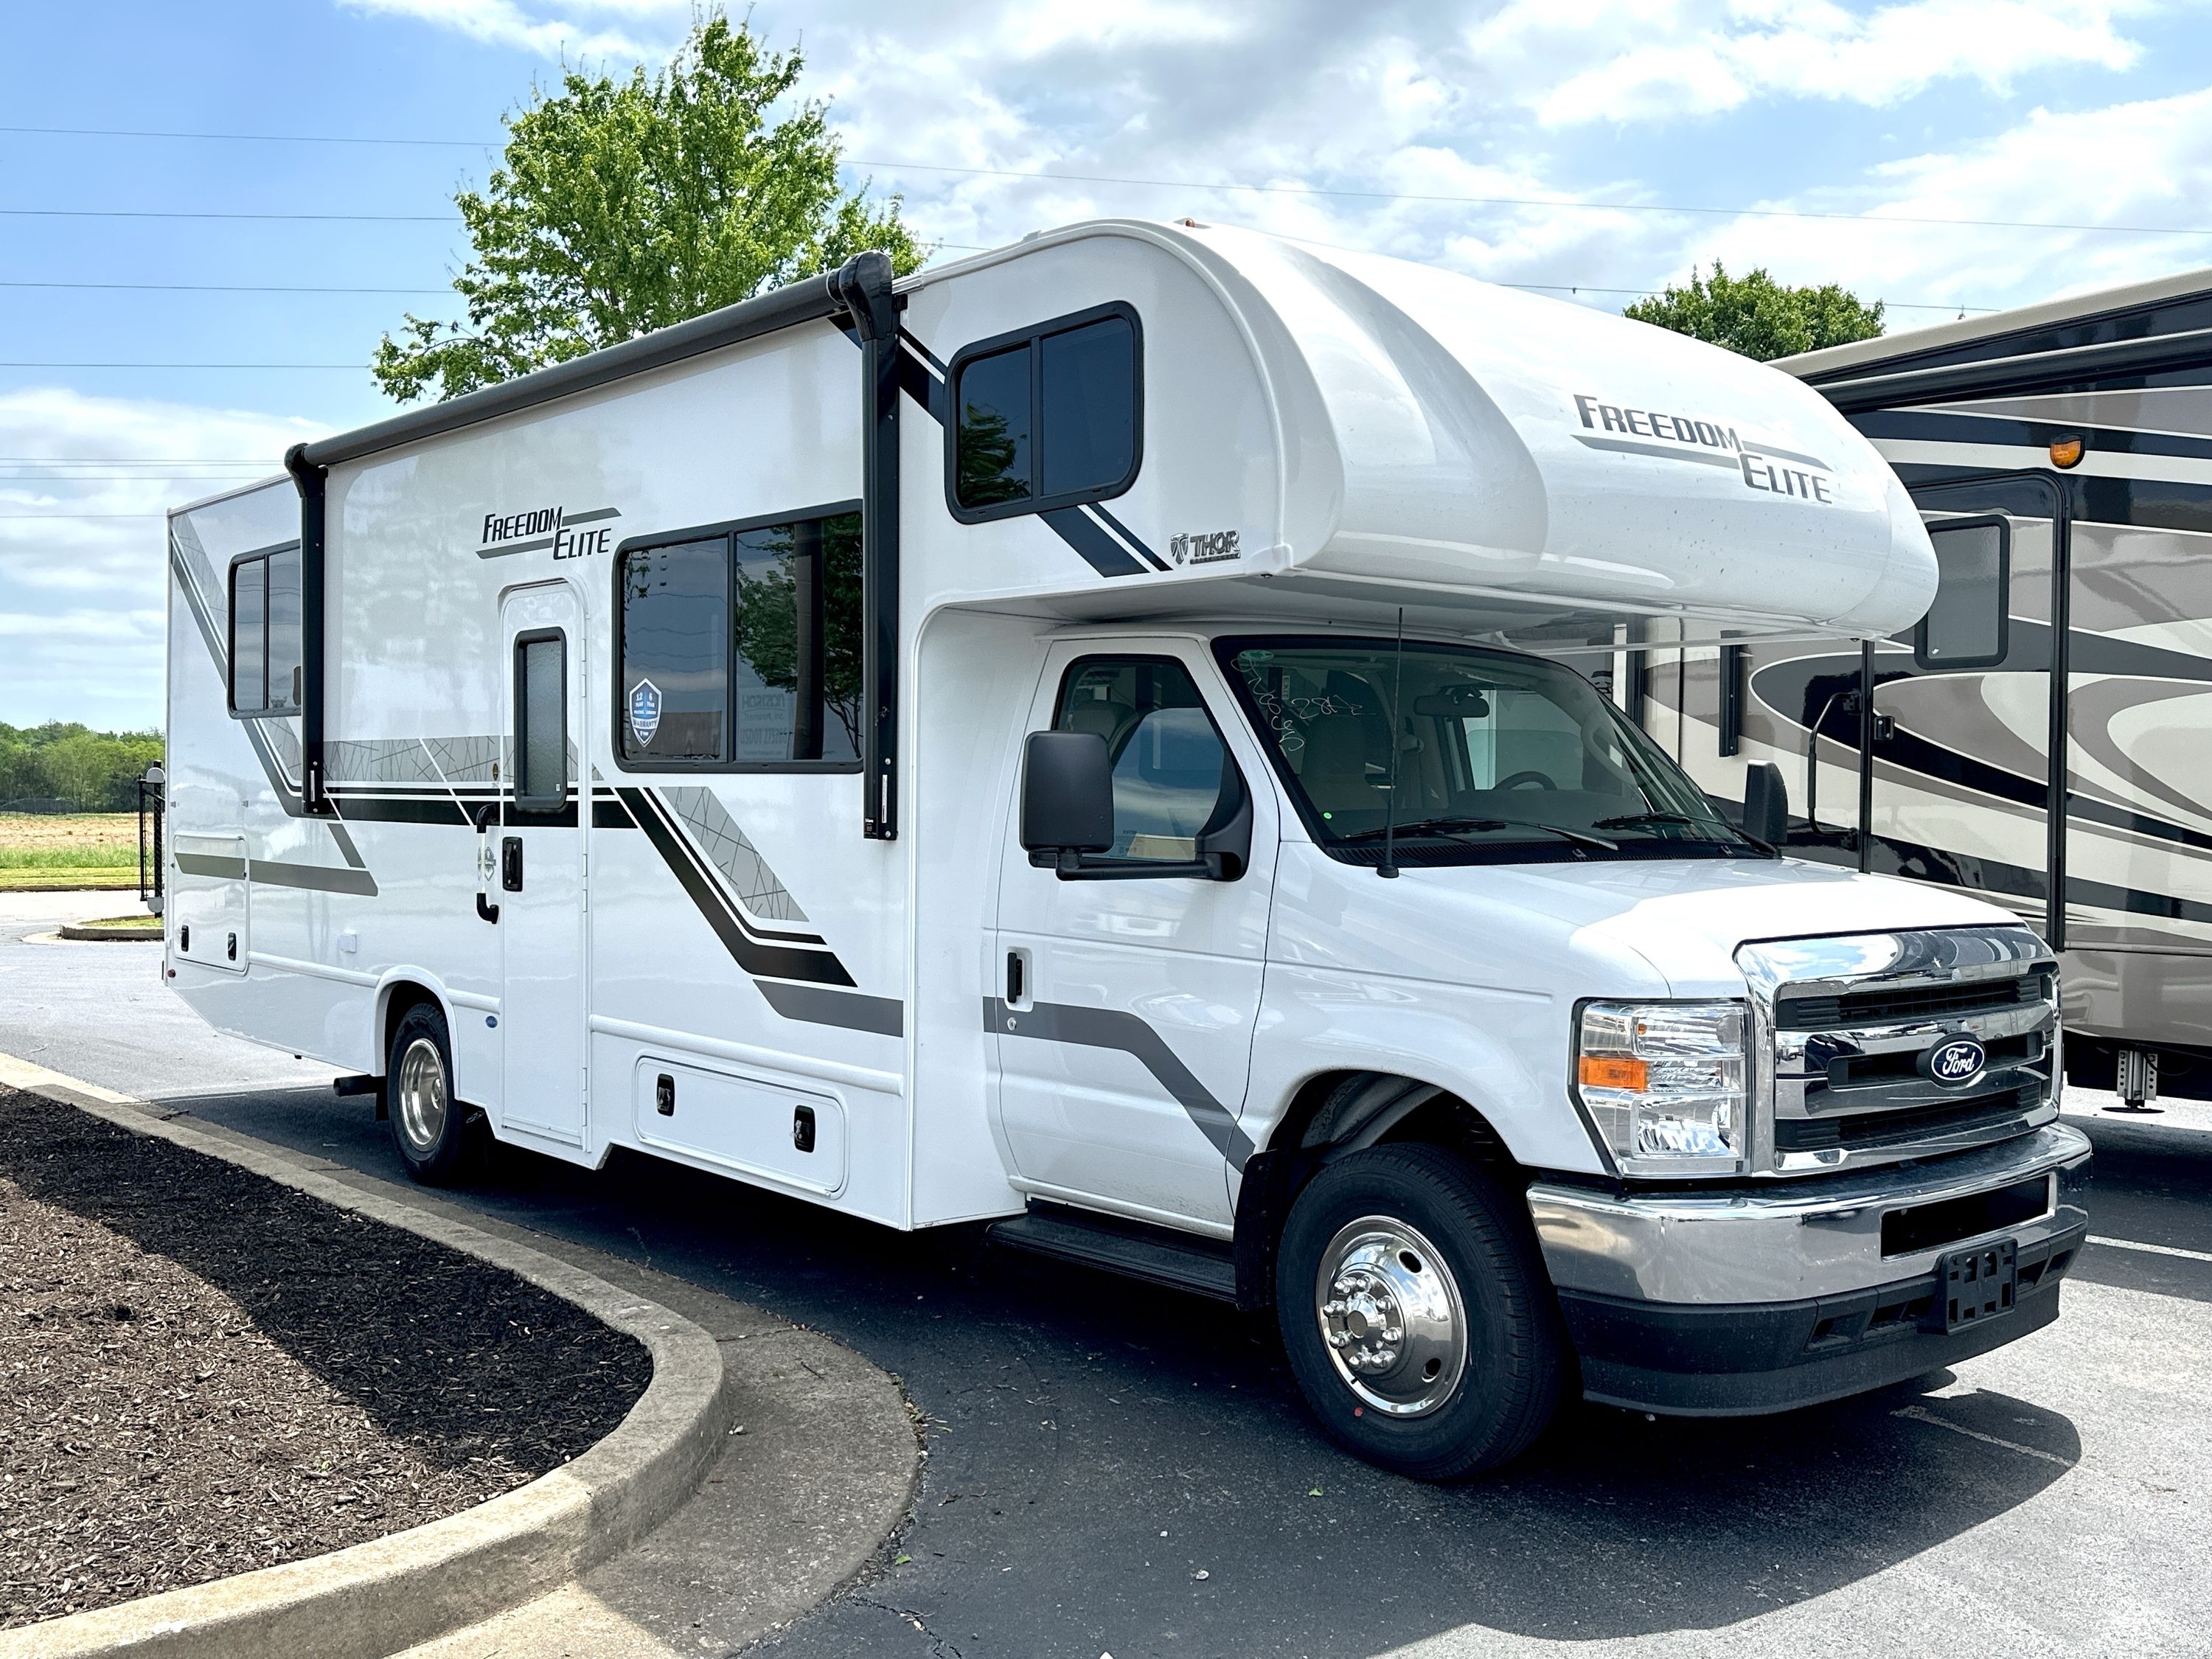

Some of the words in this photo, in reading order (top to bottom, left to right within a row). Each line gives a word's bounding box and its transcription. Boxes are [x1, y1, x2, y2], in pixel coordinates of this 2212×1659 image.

[1573, 394, 1742, 453] FREEDOM
[1739, 453, 1832, 504] ELITE
[482, 506, 563, 543] FREEDOM
[553, 528, 611, 560] ELITE
[1189, 530, 1240, 557] THOR
[1942, 1047, 1976, 1075] Ford
